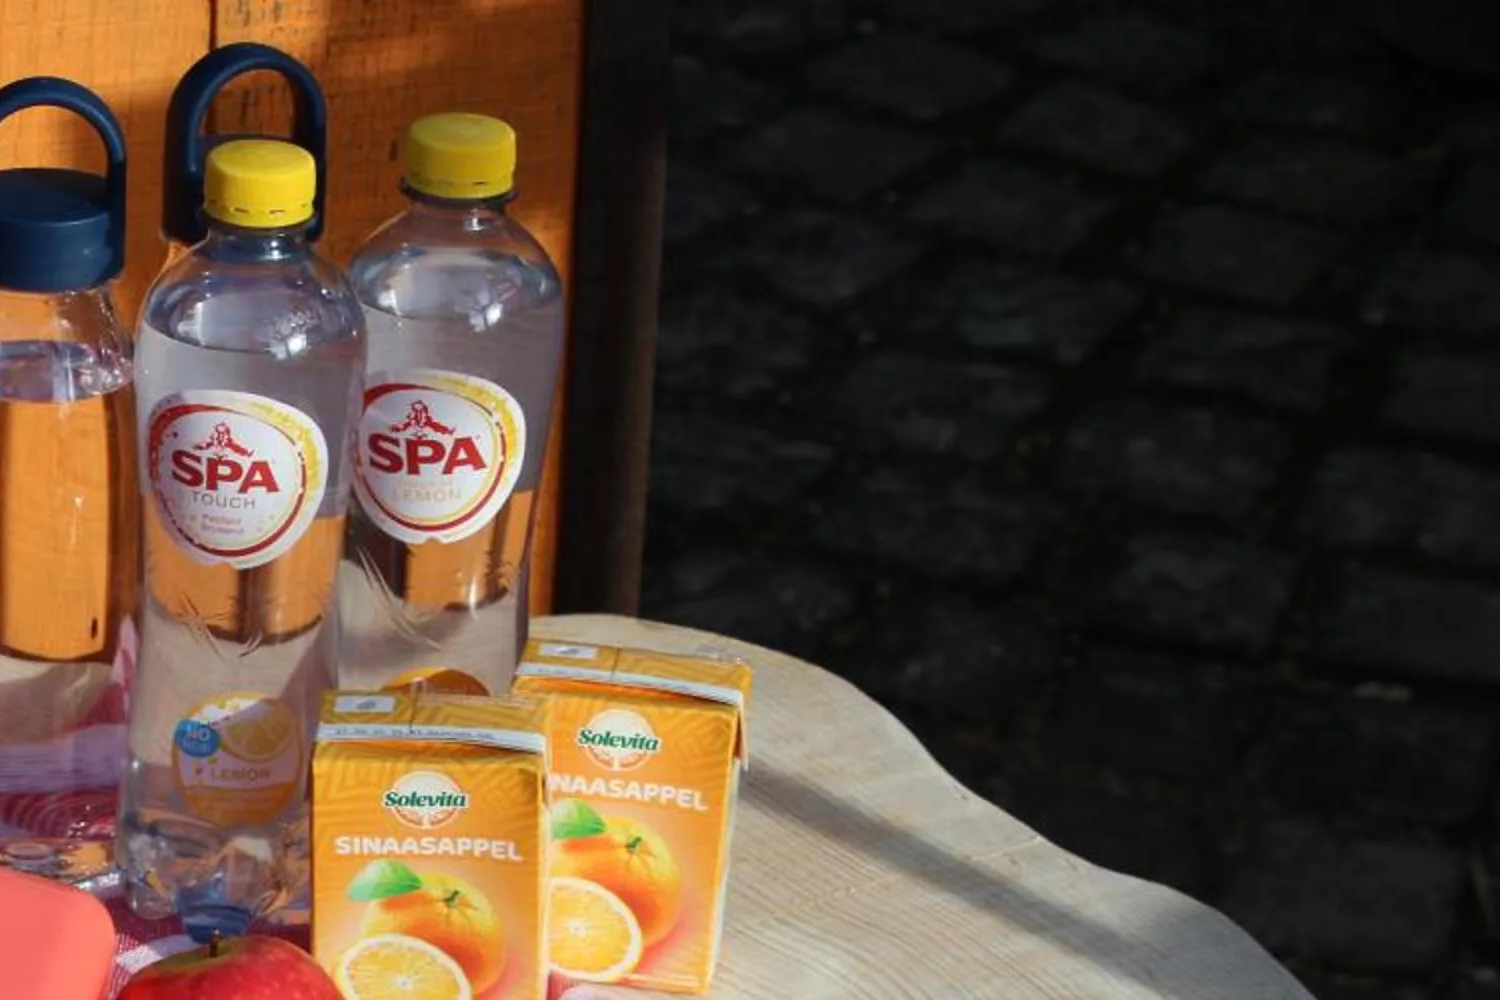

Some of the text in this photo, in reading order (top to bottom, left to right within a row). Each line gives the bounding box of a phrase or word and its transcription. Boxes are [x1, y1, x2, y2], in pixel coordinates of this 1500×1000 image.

[368, 433, 487, 475] SPA
[172, 449, 279, 494] SPA
[192, 491, 256, 509] TOUCH
[578, 728, 660, 751] Solevita
[384, 791, 466, 807] Solevita
[548, 772, 709, 811] NAASAPPEL
[335, 836, 523, 862] SINAASAPPEL
